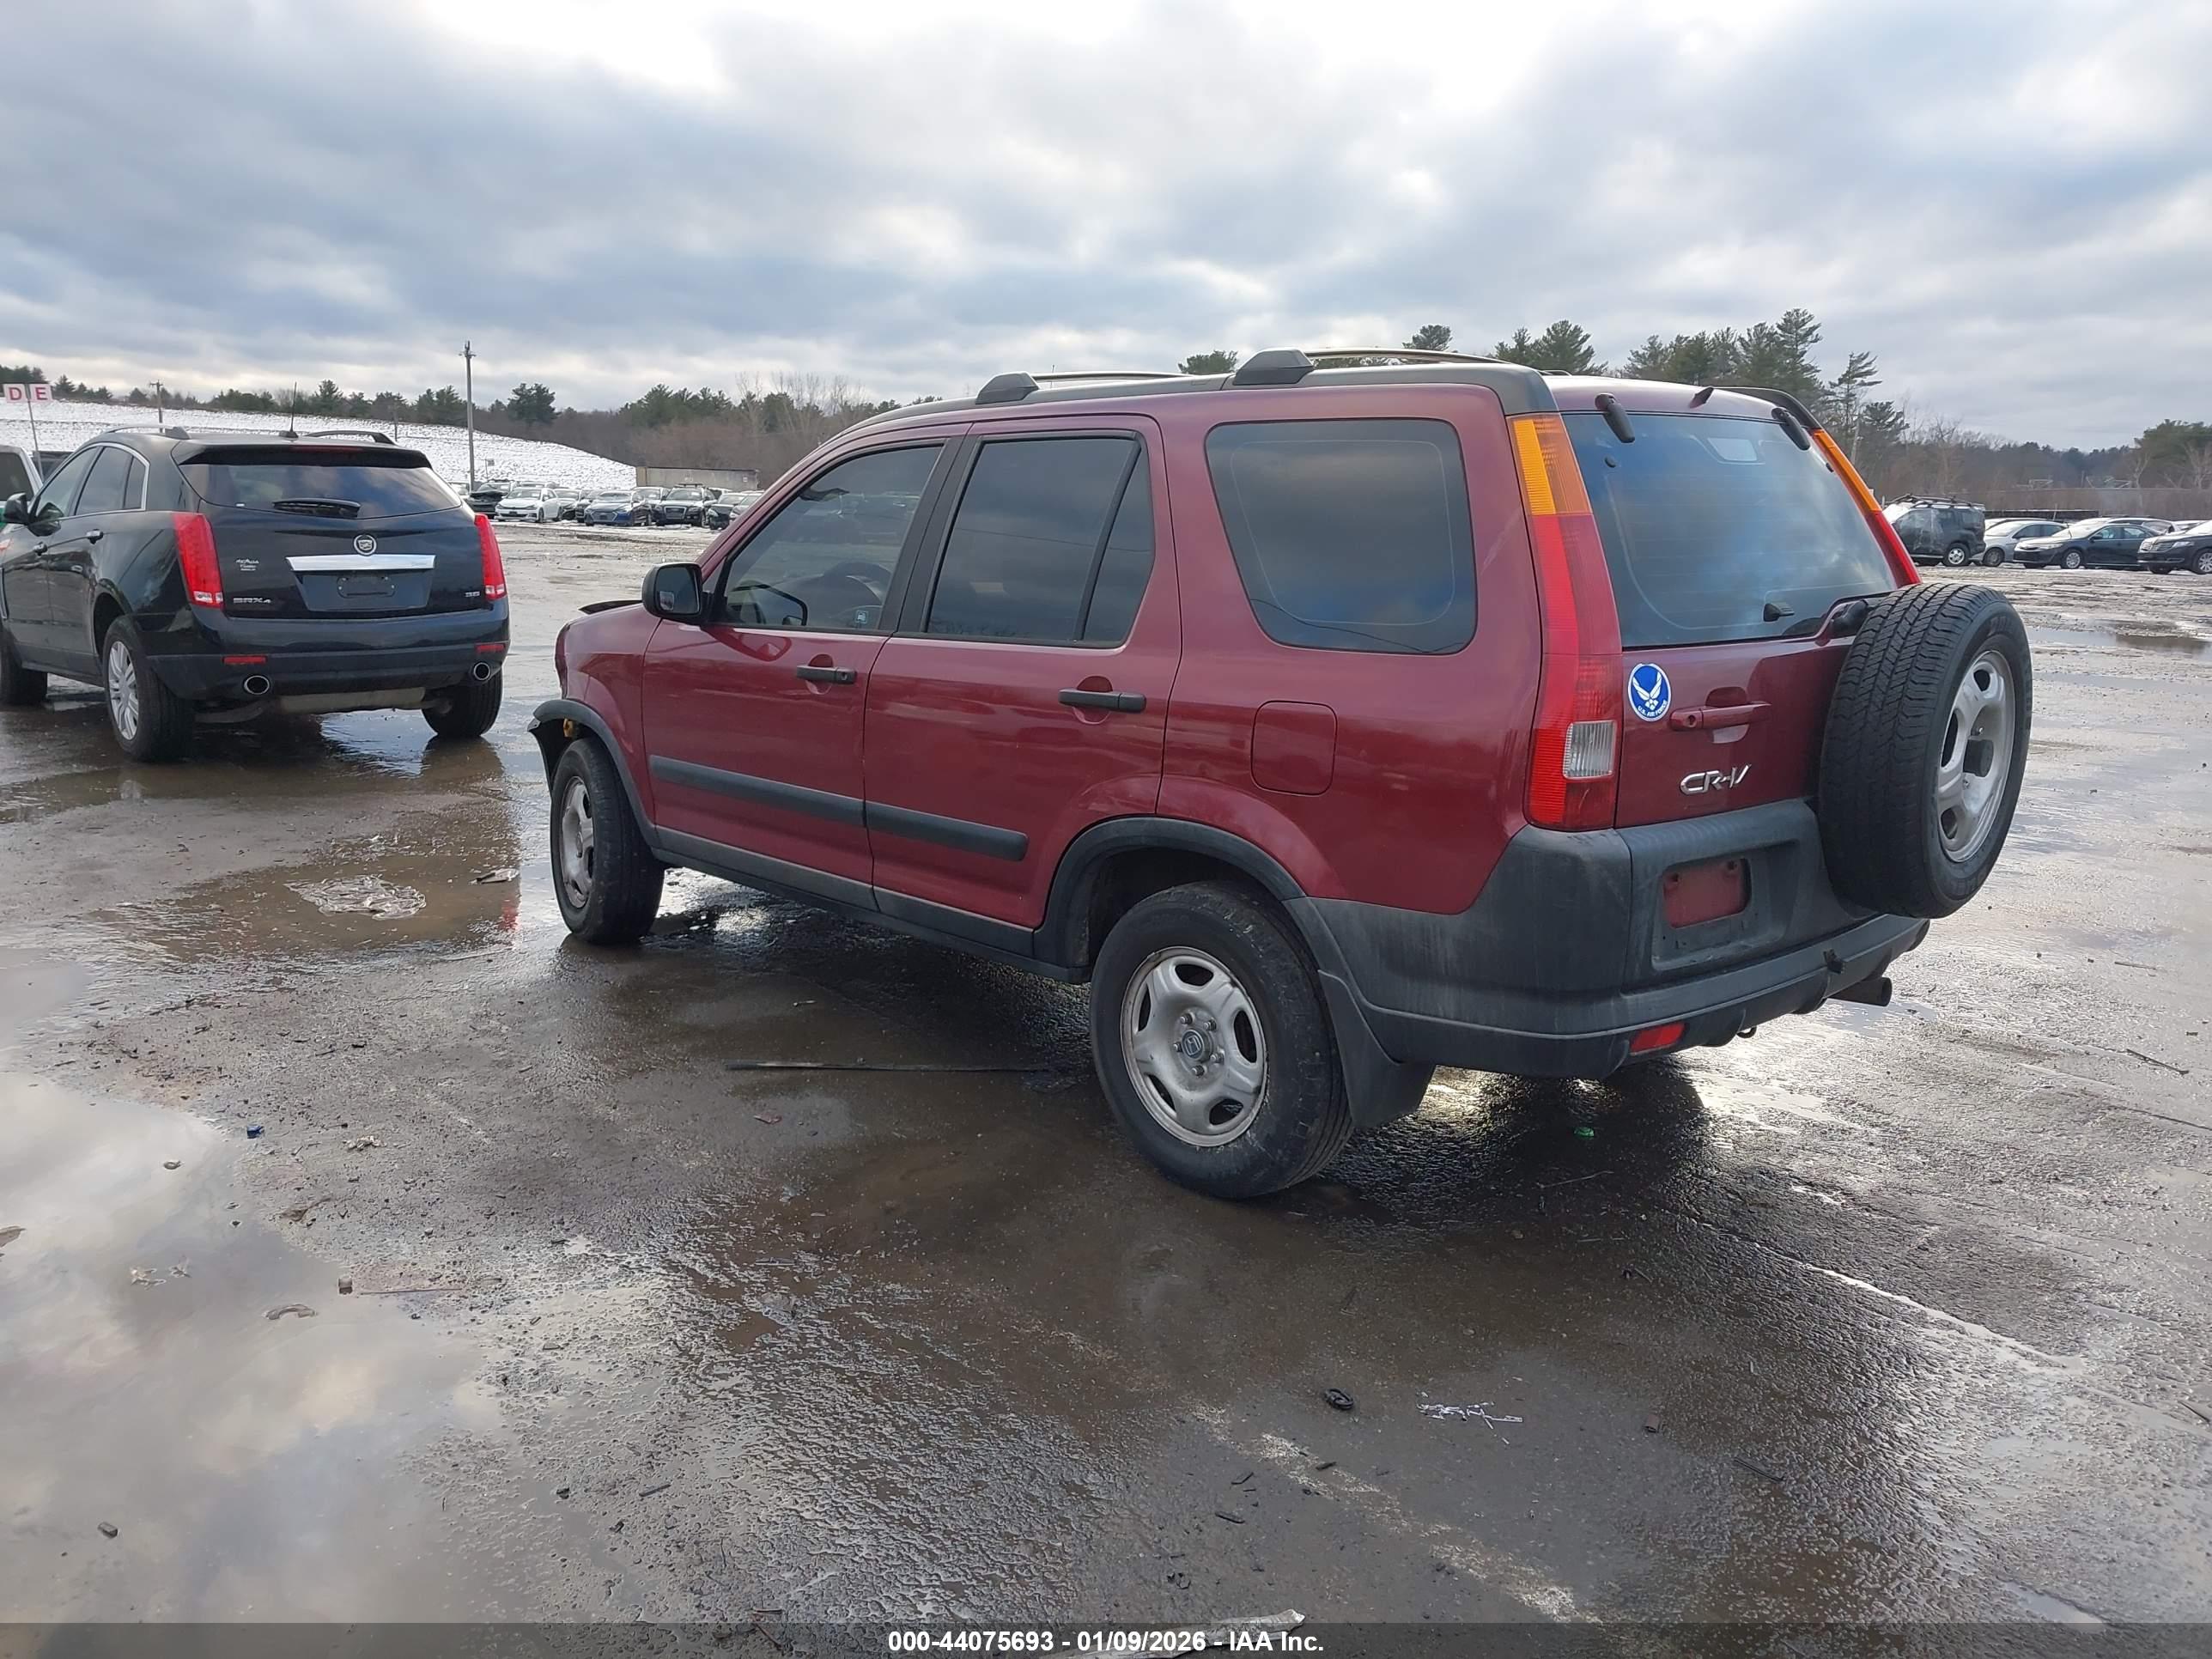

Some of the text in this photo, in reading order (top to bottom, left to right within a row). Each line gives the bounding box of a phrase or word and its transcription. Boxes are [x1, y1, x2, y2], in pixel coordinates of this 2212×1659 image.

[9, 386, 48, 401] D E
[1680, 763, 1752, 795] CR-V
